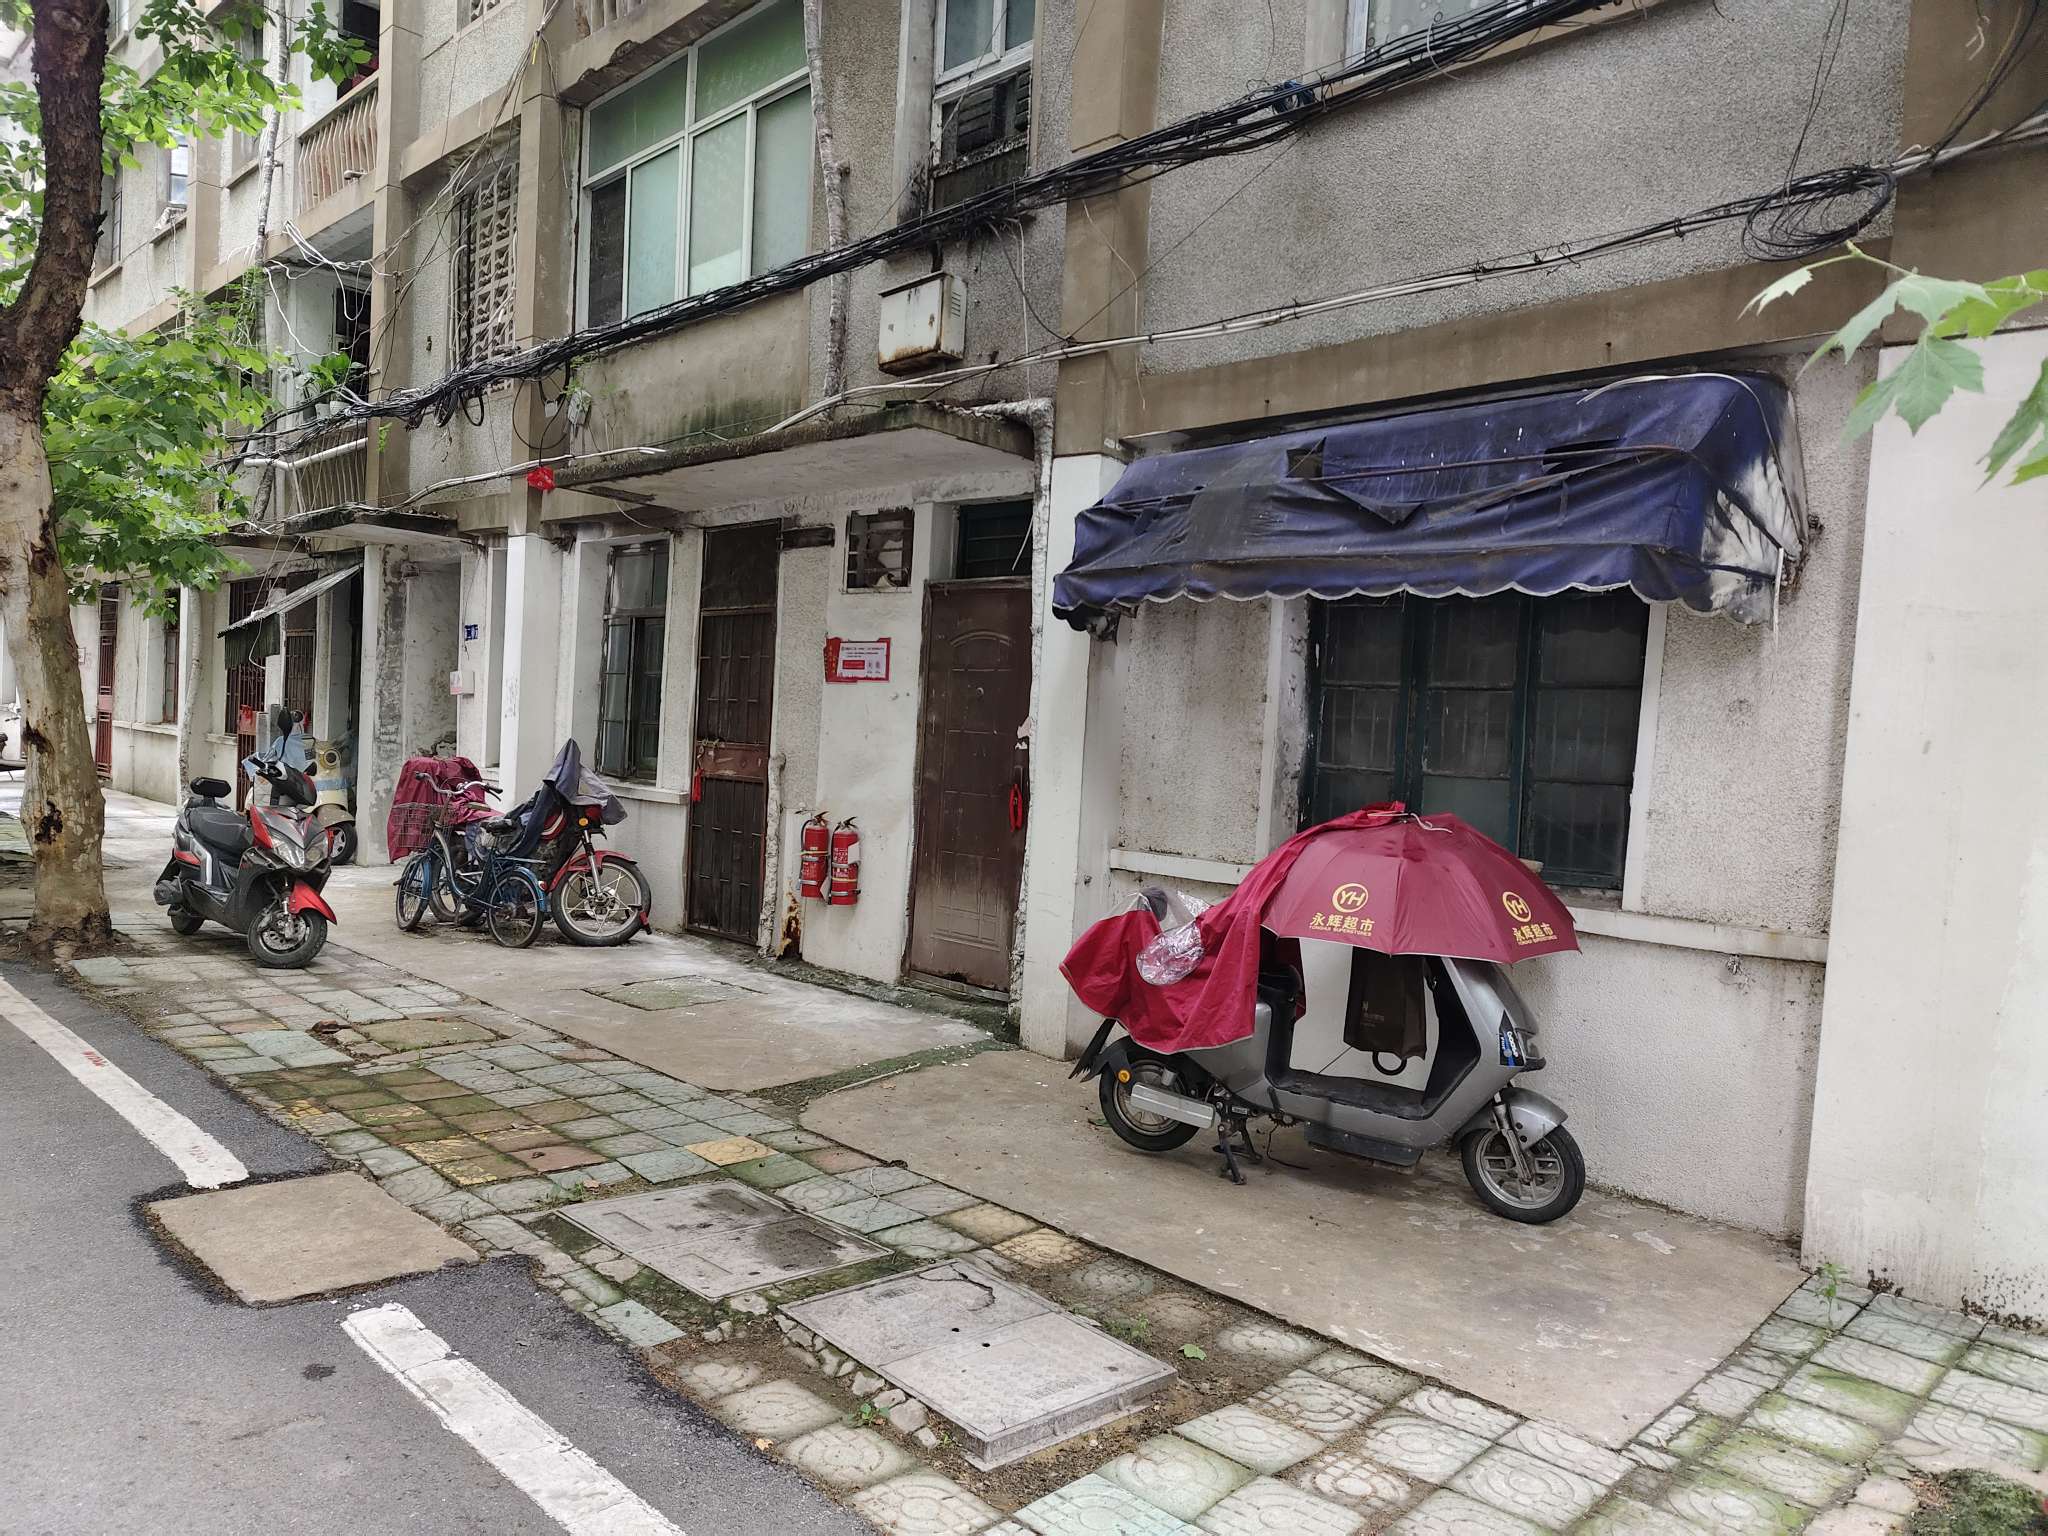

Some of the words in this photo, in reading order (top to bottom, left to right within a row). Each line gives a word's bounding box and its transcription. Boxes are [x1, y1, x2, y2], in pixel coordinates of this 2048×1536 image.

[1309, 912, 1376, 932] 永辉超市
[1511, 922, 1554, 942] 永辉超市
